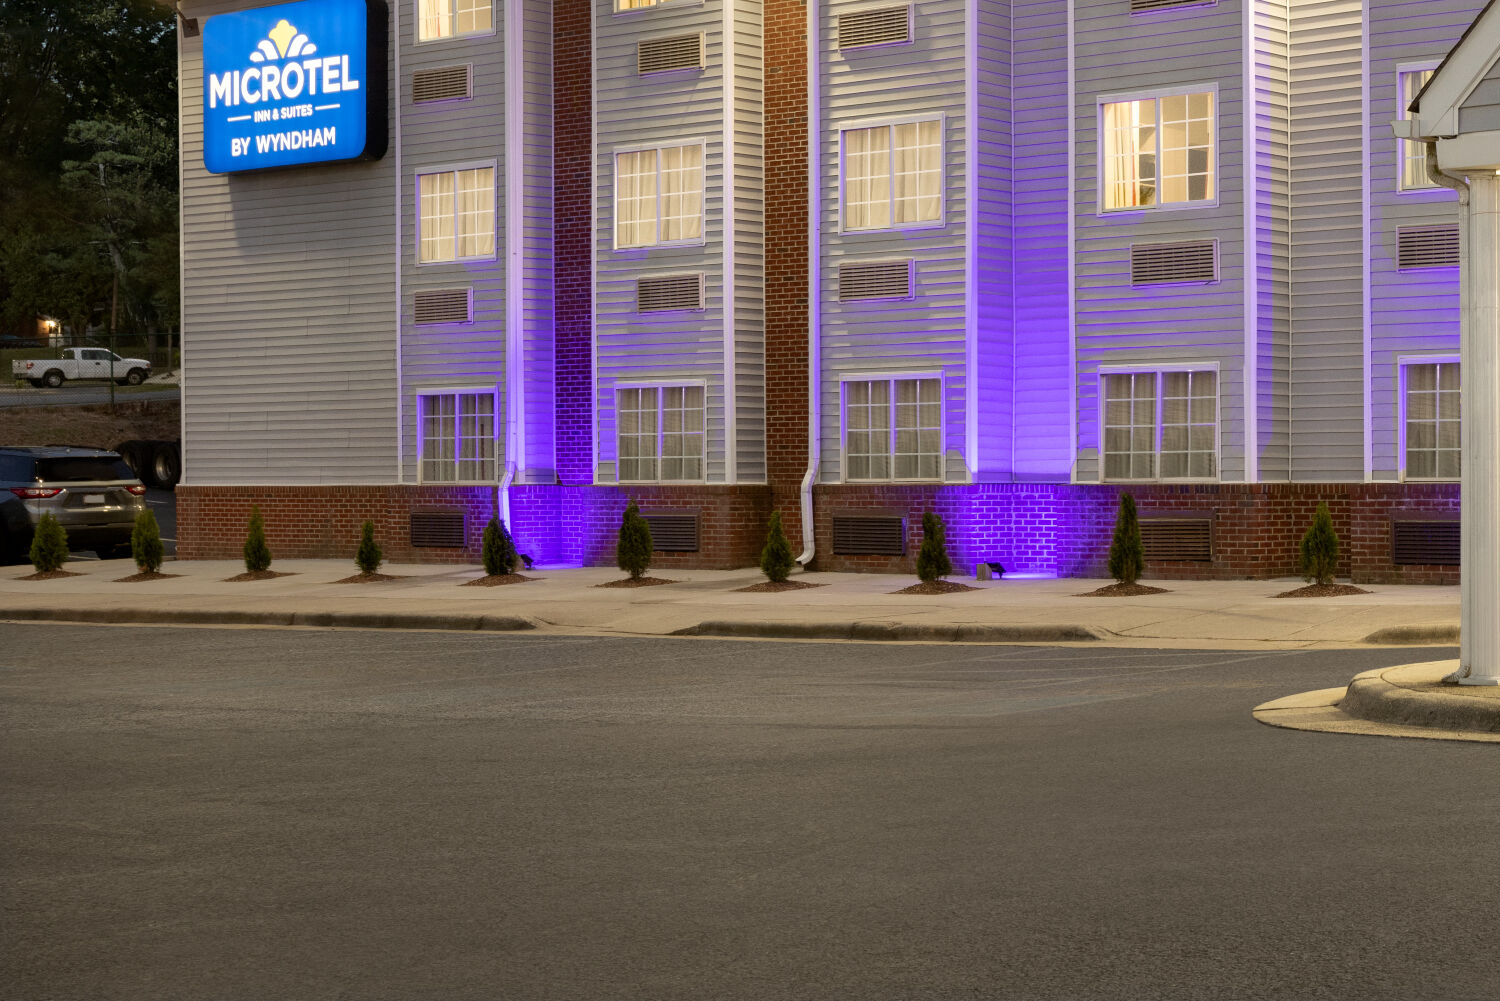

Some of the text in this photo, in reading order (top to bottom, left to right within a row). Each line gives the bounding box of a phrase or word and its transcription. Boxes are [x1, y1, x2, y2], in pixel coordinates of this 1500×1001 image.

[209, 54, 360, 109] MICROTEL
[253, 104, 313, 123] INN & SUITES
[231, 126, 336, 157] BY WYNDHAM
